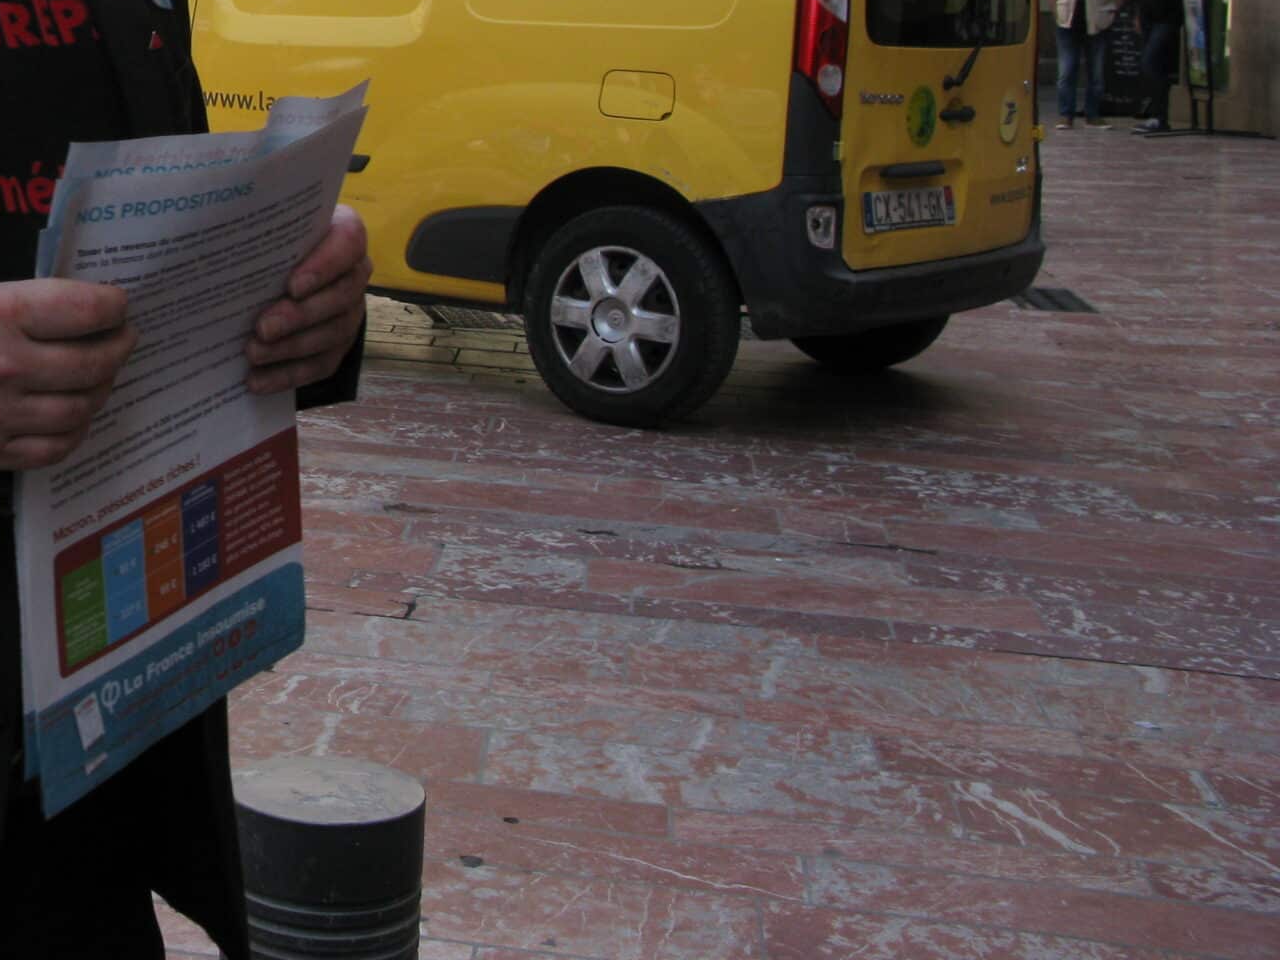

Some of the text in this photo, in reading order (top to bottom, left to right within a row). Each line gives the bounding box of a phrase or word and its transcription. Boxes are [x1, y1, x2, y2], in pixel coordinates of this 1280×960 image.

[76, 182, 256, 224] NOS PROPOSITIONS
[146, 641, 194, 681] France
